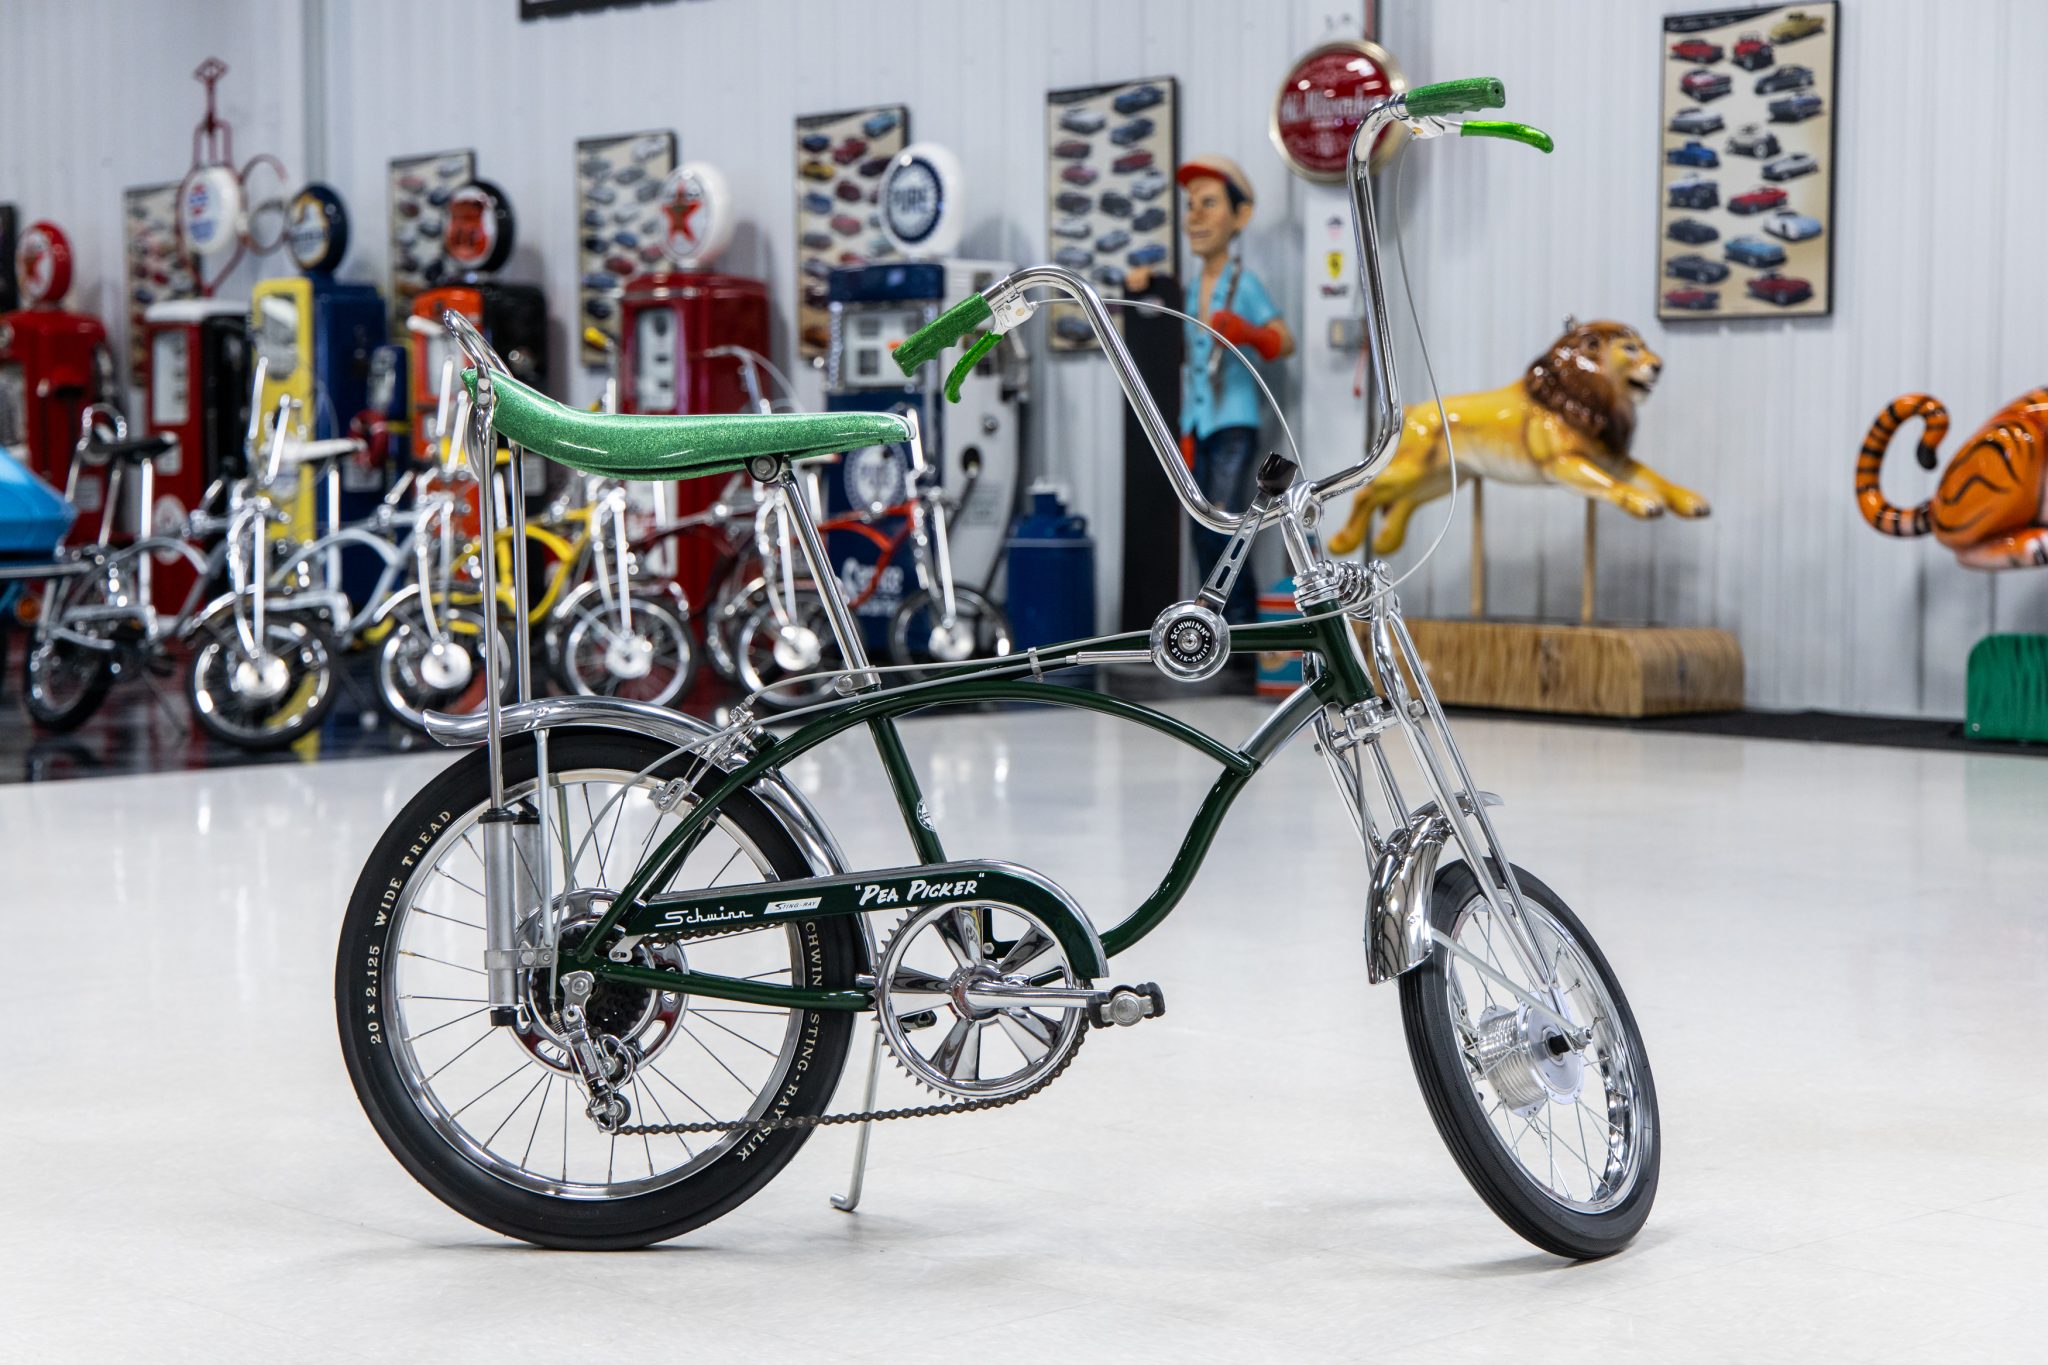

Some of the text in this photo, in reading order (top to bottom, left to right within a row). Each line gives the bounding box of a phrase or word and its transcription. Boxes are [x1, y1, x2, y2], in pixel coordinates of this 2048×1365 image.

[1170, 620, 1208, 640] SCHWINN
[1171, 643, 1210, 662] STIK-SHIFT
[402, 810, 451, 868] TREAD
[374, 877, 402, 928] WIDE
[655, 906, 753, 927] Schwinn
[365, 945, 380, 998] 2.125
[805, 922, 822, 987] CHWIN
[367, 1021, 382, 1045] 20
[736, 1126, 772, 1162] SLIK
